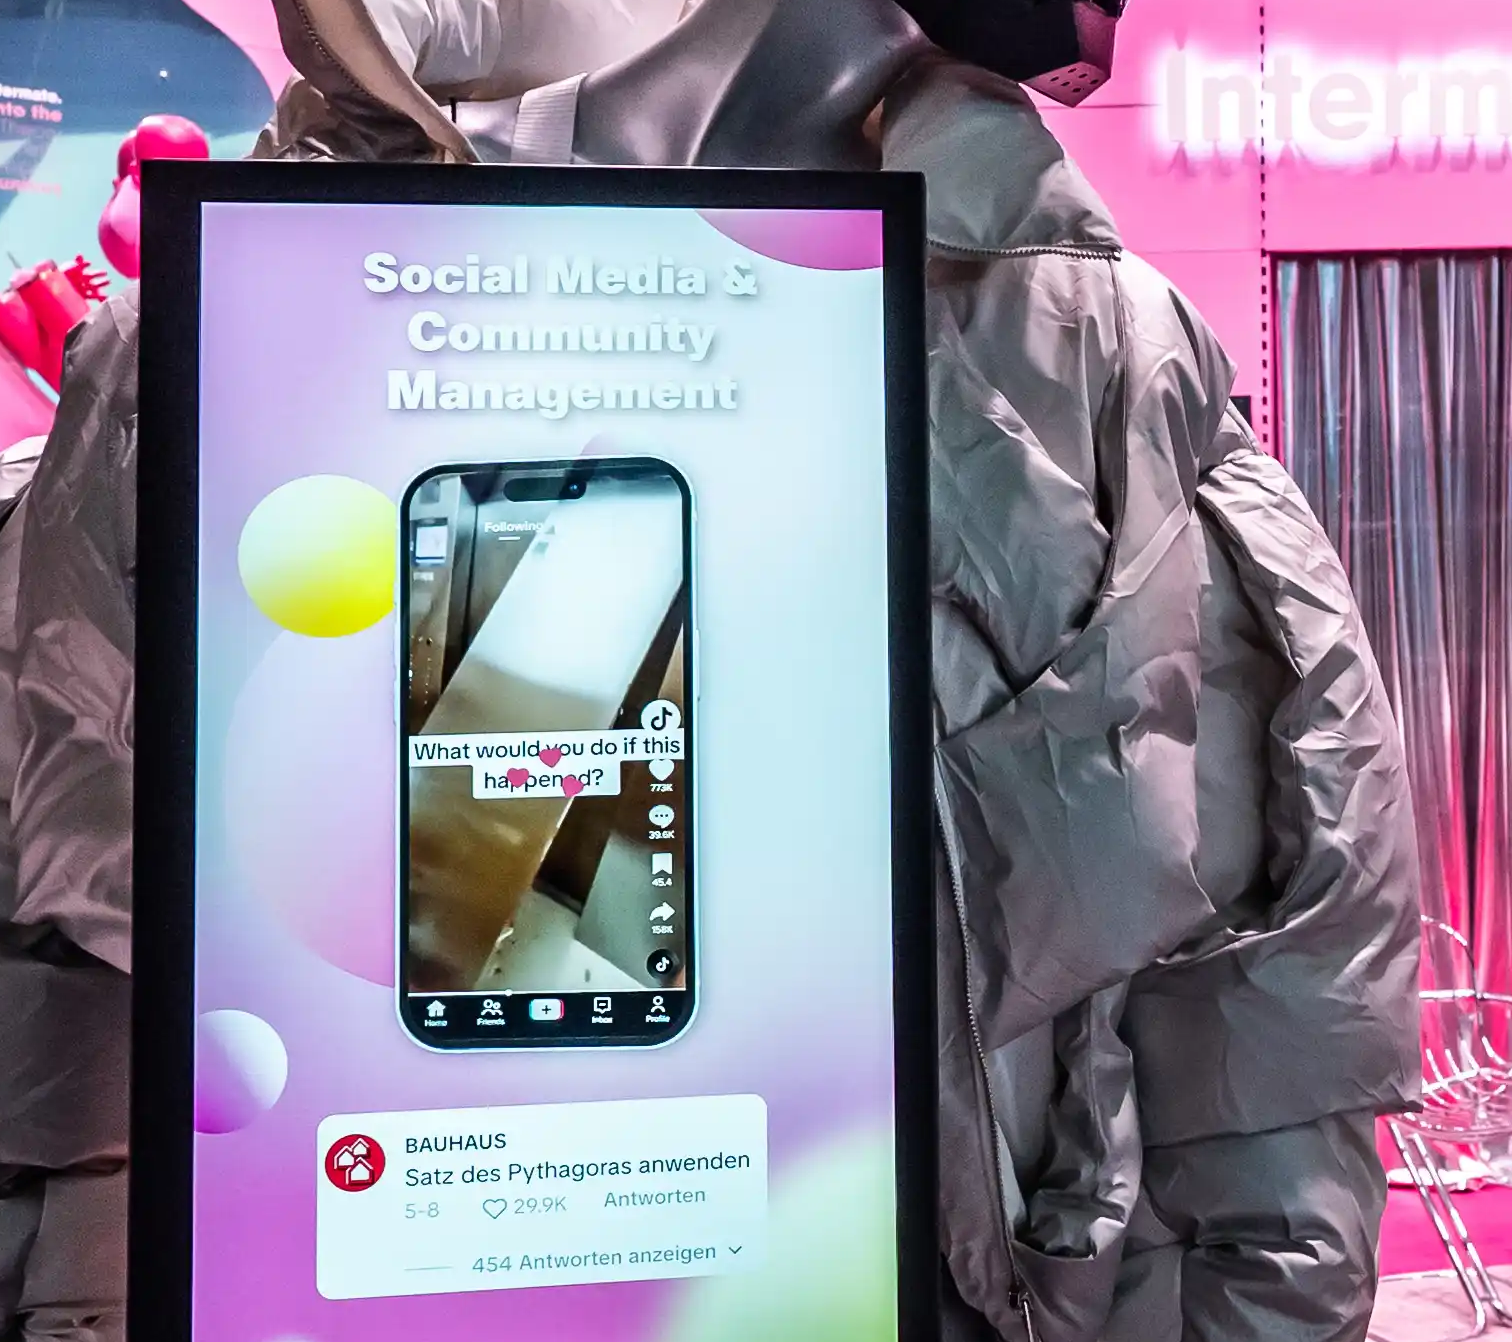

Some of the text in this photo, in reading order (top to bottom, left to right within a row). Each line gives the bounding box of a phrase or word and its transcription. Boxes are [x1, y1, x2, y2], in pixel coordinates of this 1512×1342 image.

[31, 104, 64, 123] the
[363, 251, 760, 298] Social Media &
[407, 311, 717, 362] Community
[386, 370, 738, 419] Management
[415, 736, 680, 760] What would do if this
[405, 1133, 507, 1154] BAUHAUS
[405, 1151, 751, 1188] Satz des Pythagoras anwenden
[405, 1186, 706, 1220] 5-8 29.9K Antworten
[471, 1243, 717, 1274] 454 Antworten anzeigen
